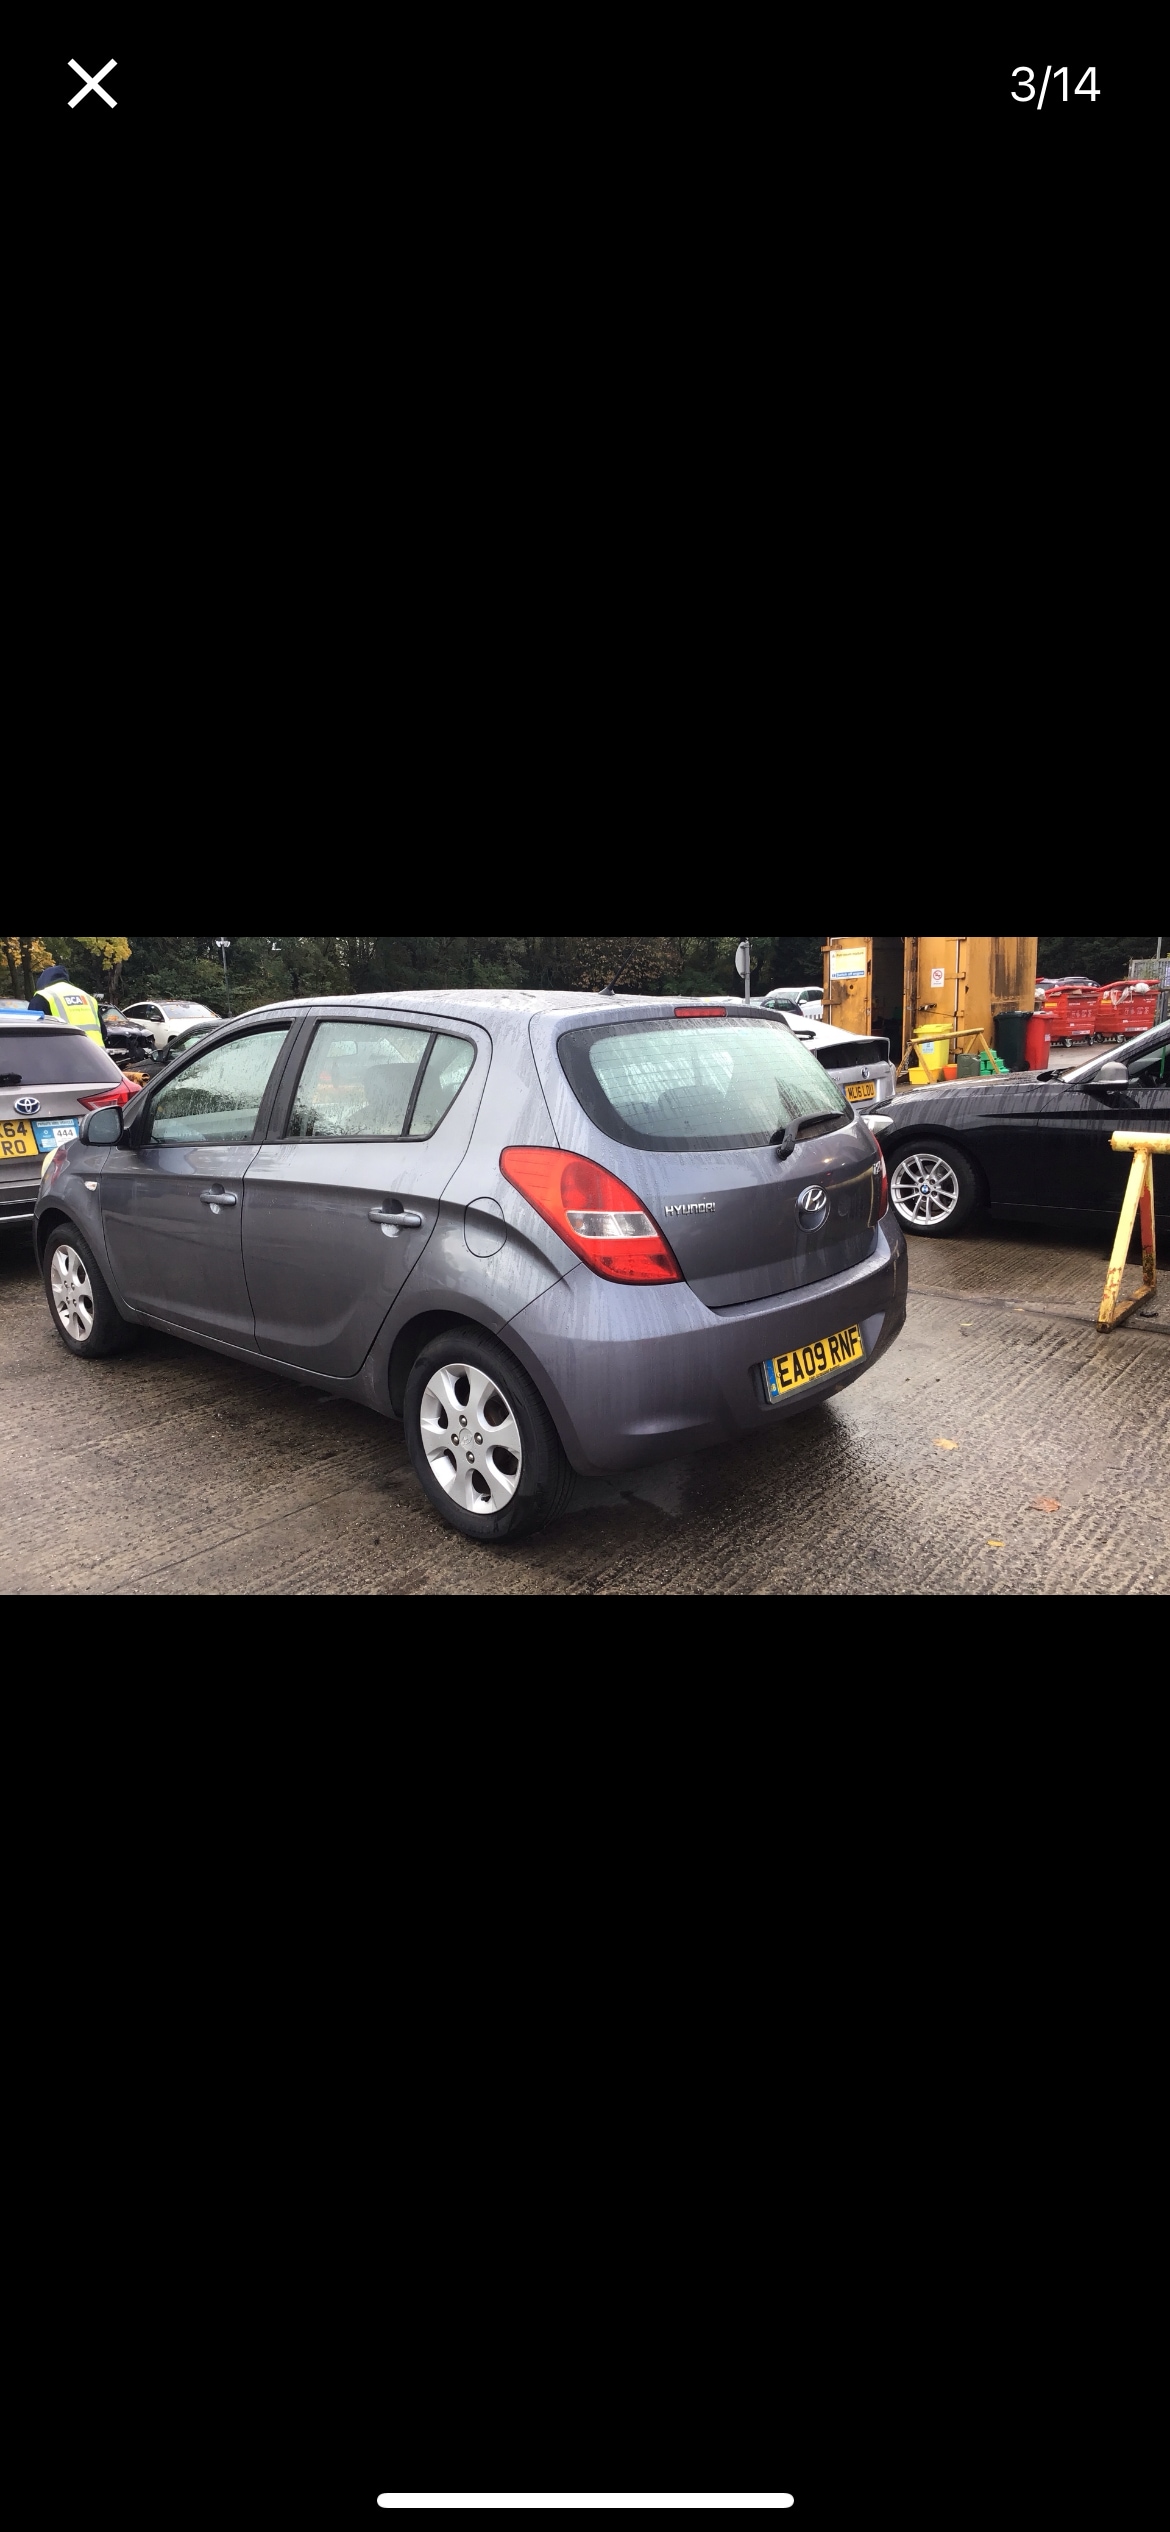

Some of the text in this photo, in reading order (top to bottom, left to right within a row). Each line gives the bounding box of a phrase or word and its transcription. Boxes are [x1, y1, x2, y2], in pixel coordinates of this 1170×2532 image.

[65, 996, 83, 1005] BCA
[57, 1129, 74, 1137] 444
[664, 1202, 716, 1217] HYUNDAI
[776, 1326, 858, 1388] EA09 RNF
